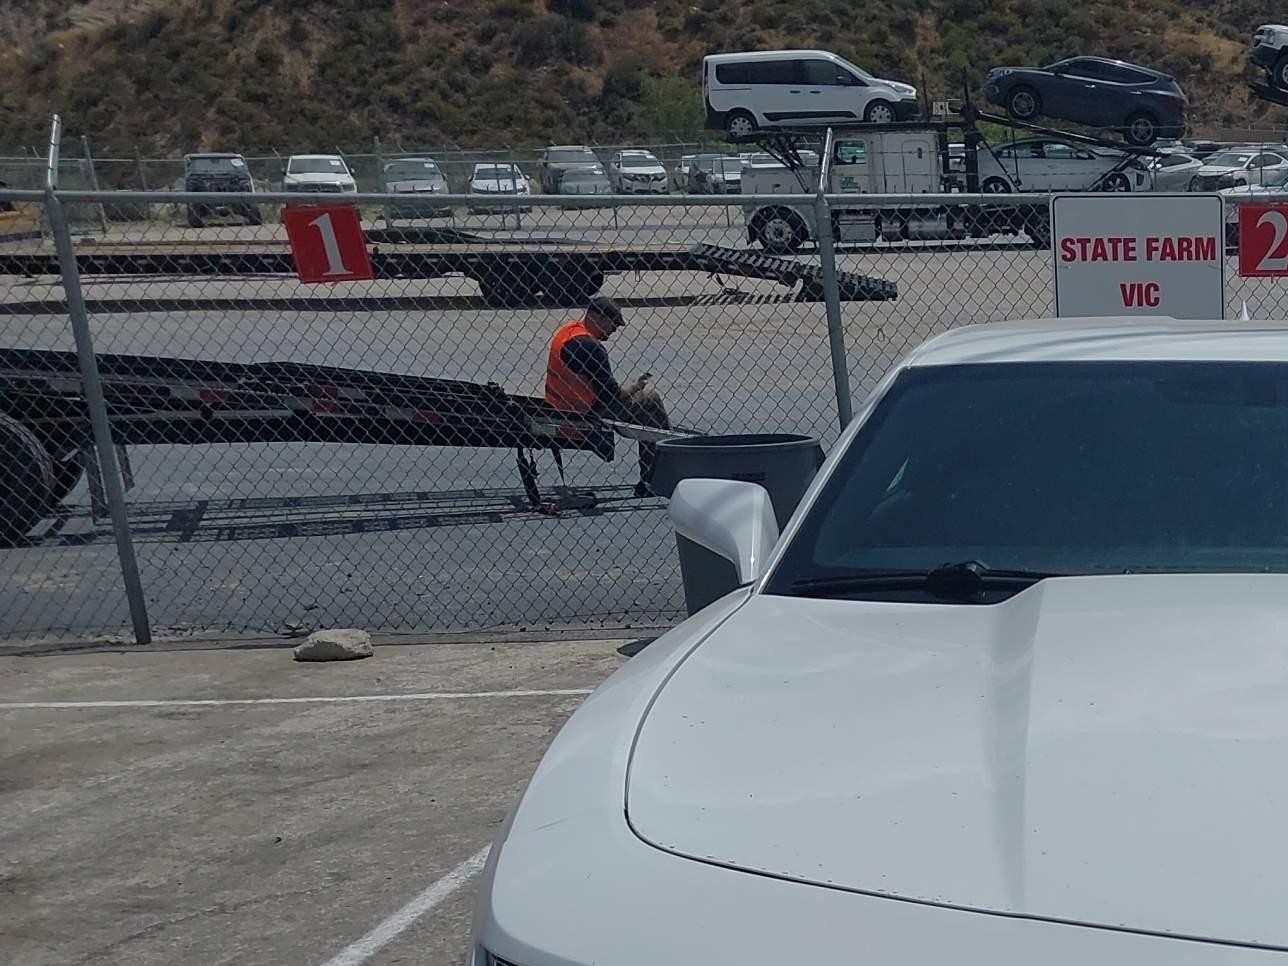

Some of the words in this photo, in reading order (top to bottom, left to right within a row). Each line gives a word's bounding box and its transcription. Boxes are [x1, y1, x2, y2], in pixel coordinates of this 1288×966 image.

[308, 212, 354, 276] 1
[1060, 237, 1137, 262] STATE
[1146, 237, 1216, 262] FARM
[1120, 283, 1161, 308] VIC
